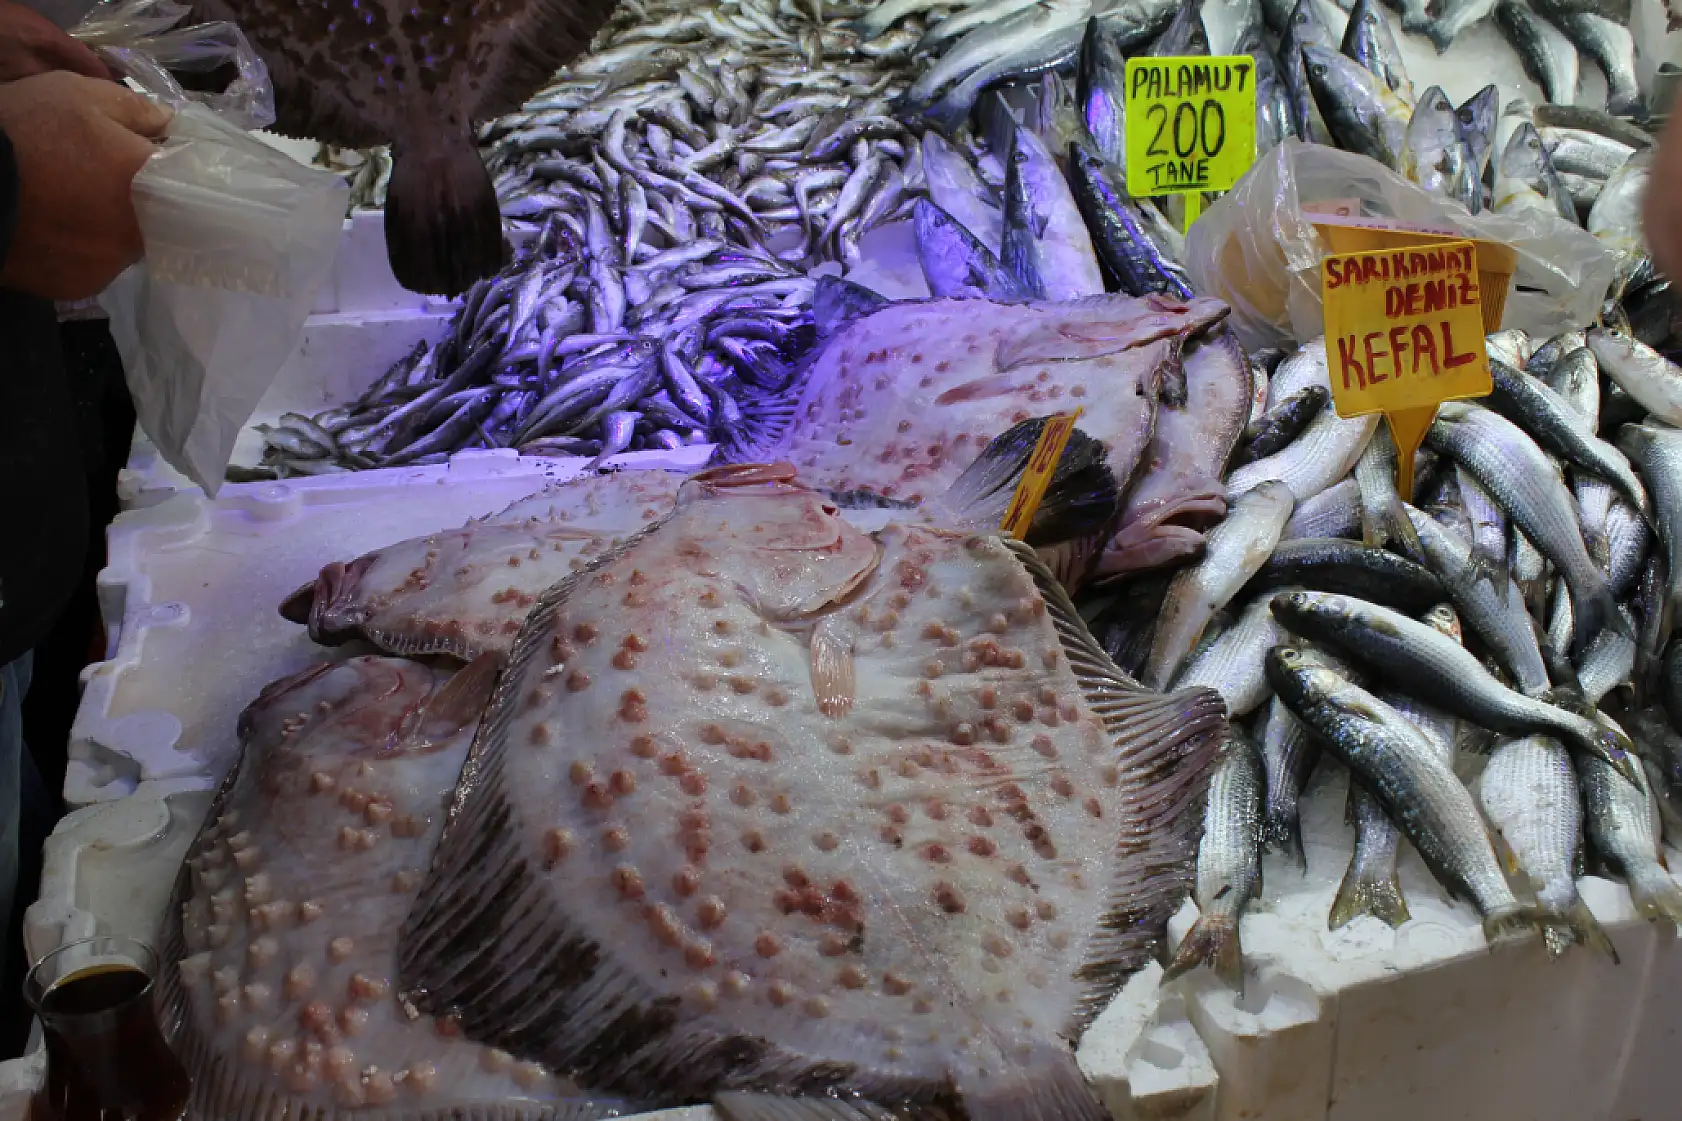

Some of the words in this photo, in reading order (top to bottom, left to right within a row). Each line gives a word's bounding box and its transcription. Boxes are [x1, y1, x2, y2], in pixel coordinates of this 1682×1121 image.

[1132, 64, 1250, 99] PALAMUT
[1146, 99, 1225, 158] 200
[1146, 158, 1209, 186] TANE
[1326, 248, 1472, 288] SARIKANAT
[1337, 321, 1477, 391] KEFAL
